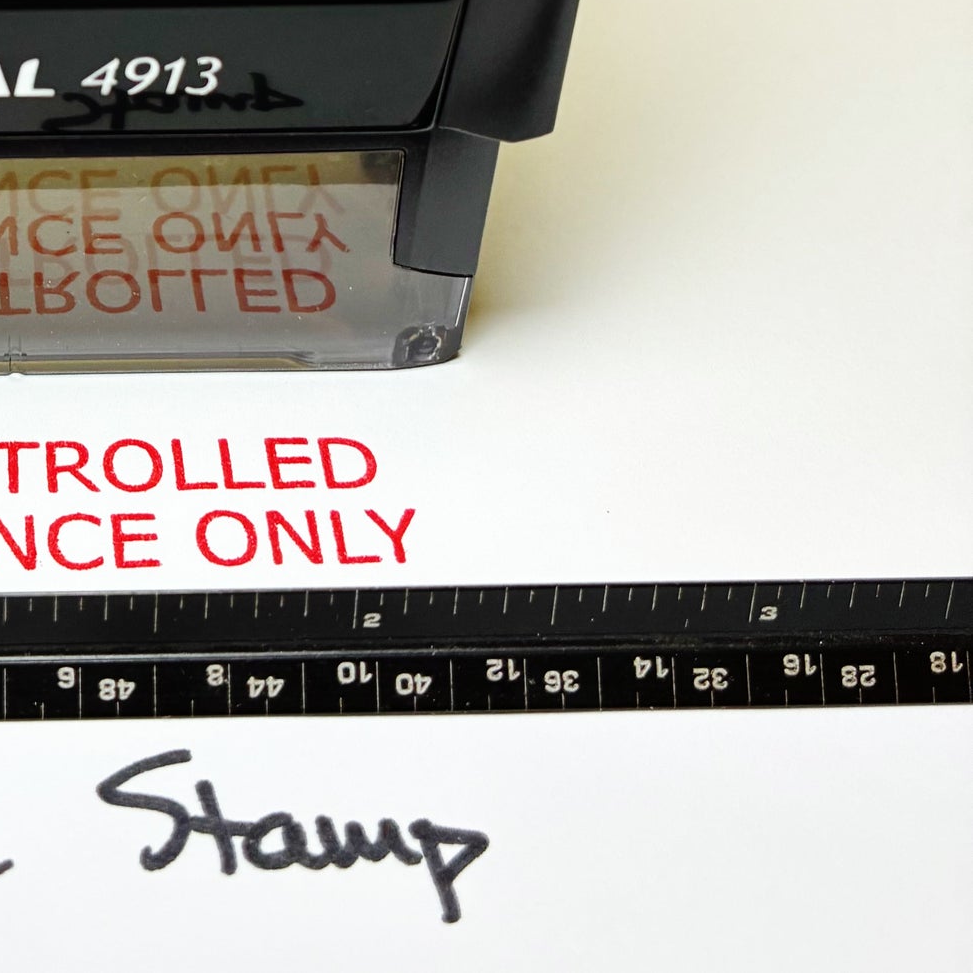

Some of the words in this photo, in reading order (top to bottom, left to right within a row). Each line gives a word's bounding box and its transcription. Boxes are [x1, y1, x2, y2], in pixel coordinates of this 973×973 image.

[81, 55, 222, 96] 4913
[195, 508, 416, 568] ONLY
[363, 612, 382, 628] 2
[758, 605, 779, 621] 3
[337, 661, 373, 685] 10
[486, 658, 521, 682] 12
[633, 656, 669, 679] 14
[782, 653, 817, 676] 16
[929, 651, 964, 673] 18
[246, 675, 285, 698] 44
[395, 672, 433, 696] 40
[544, 669, 580, 693] 36
[692, 667, 728, 690] 32
[841, 664, 876, 688] 28
[98, 678, 136, 701] 48
[96, 749, 490, 924] Stamp
